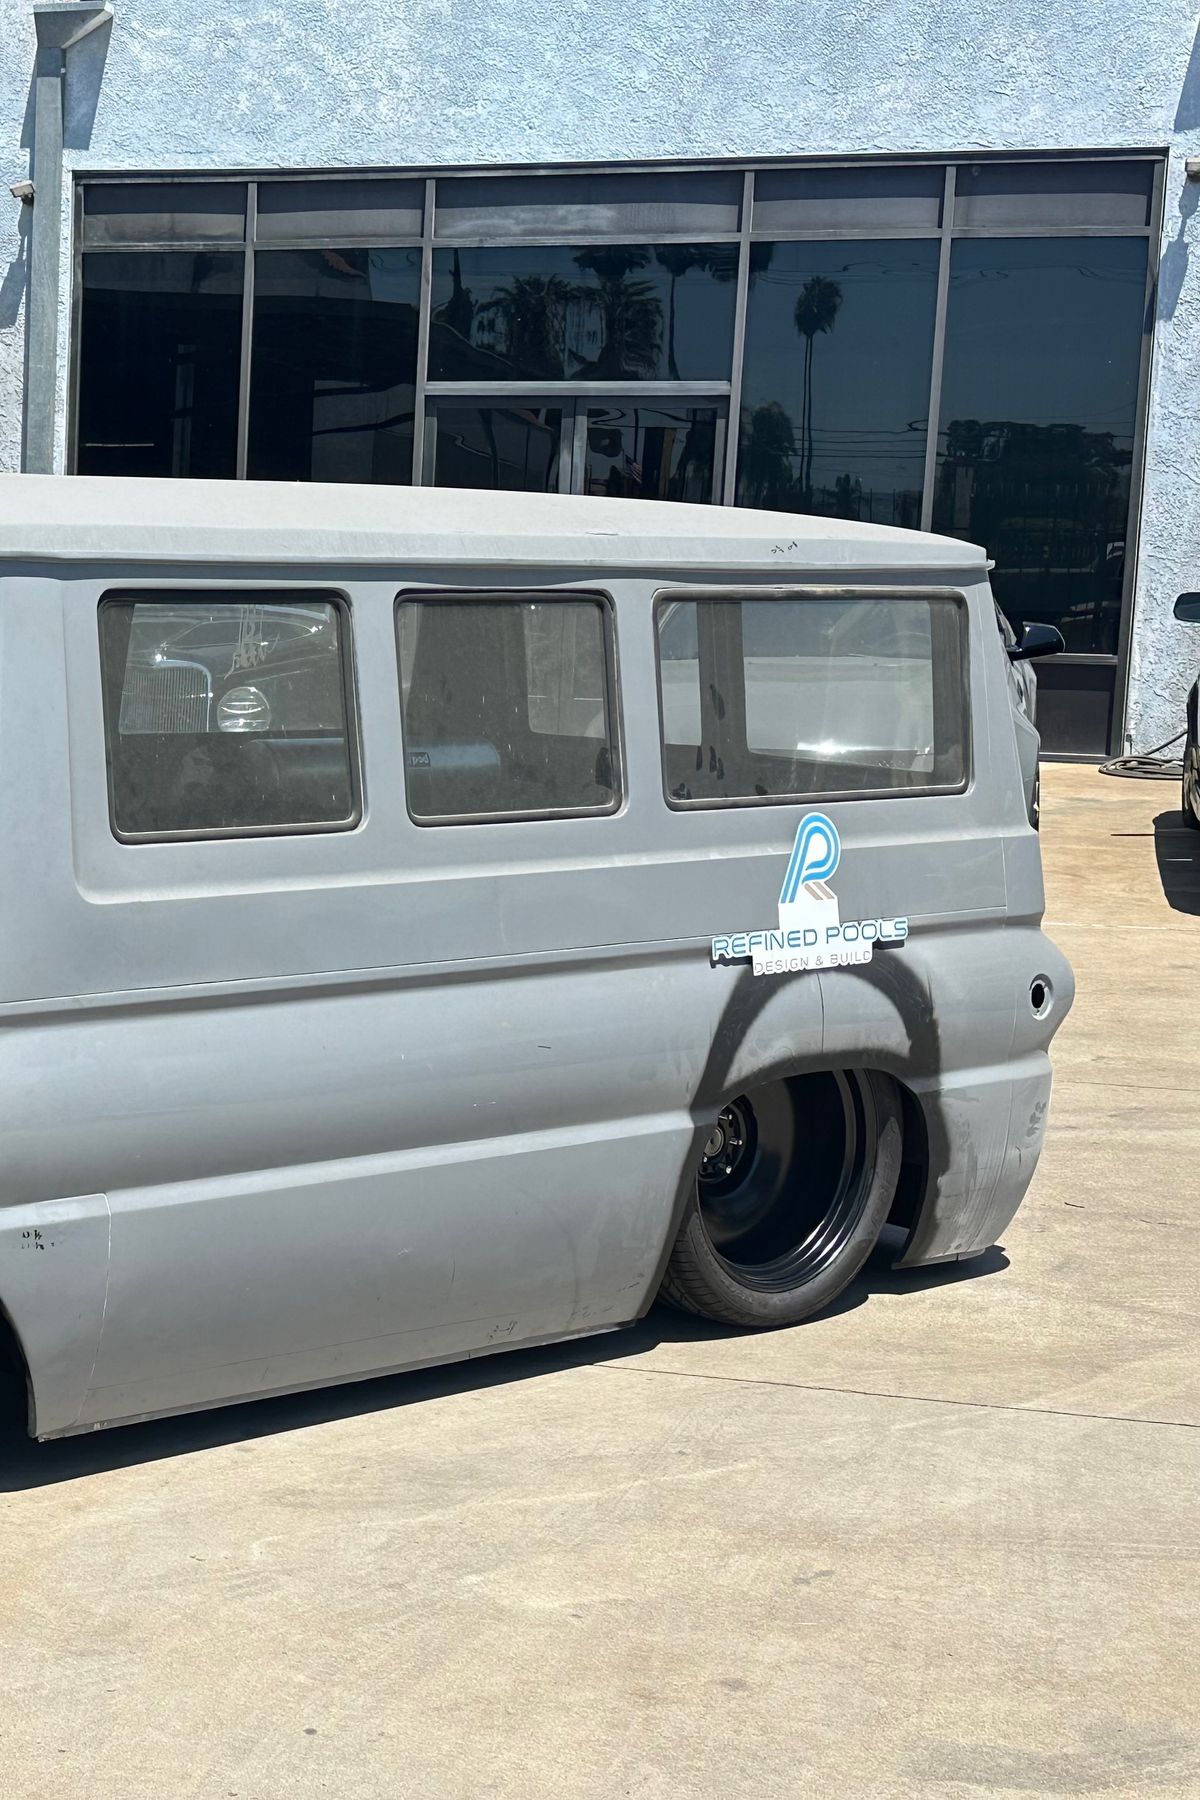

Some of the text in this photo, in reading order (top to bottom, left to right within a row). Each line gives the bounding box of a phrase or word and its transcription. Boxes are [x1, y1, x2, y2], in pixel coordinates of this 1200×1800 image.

[713, 921, 908, 958] REFINED POOLS
[754, 951, 871, 974] DESIGN & BUILD
